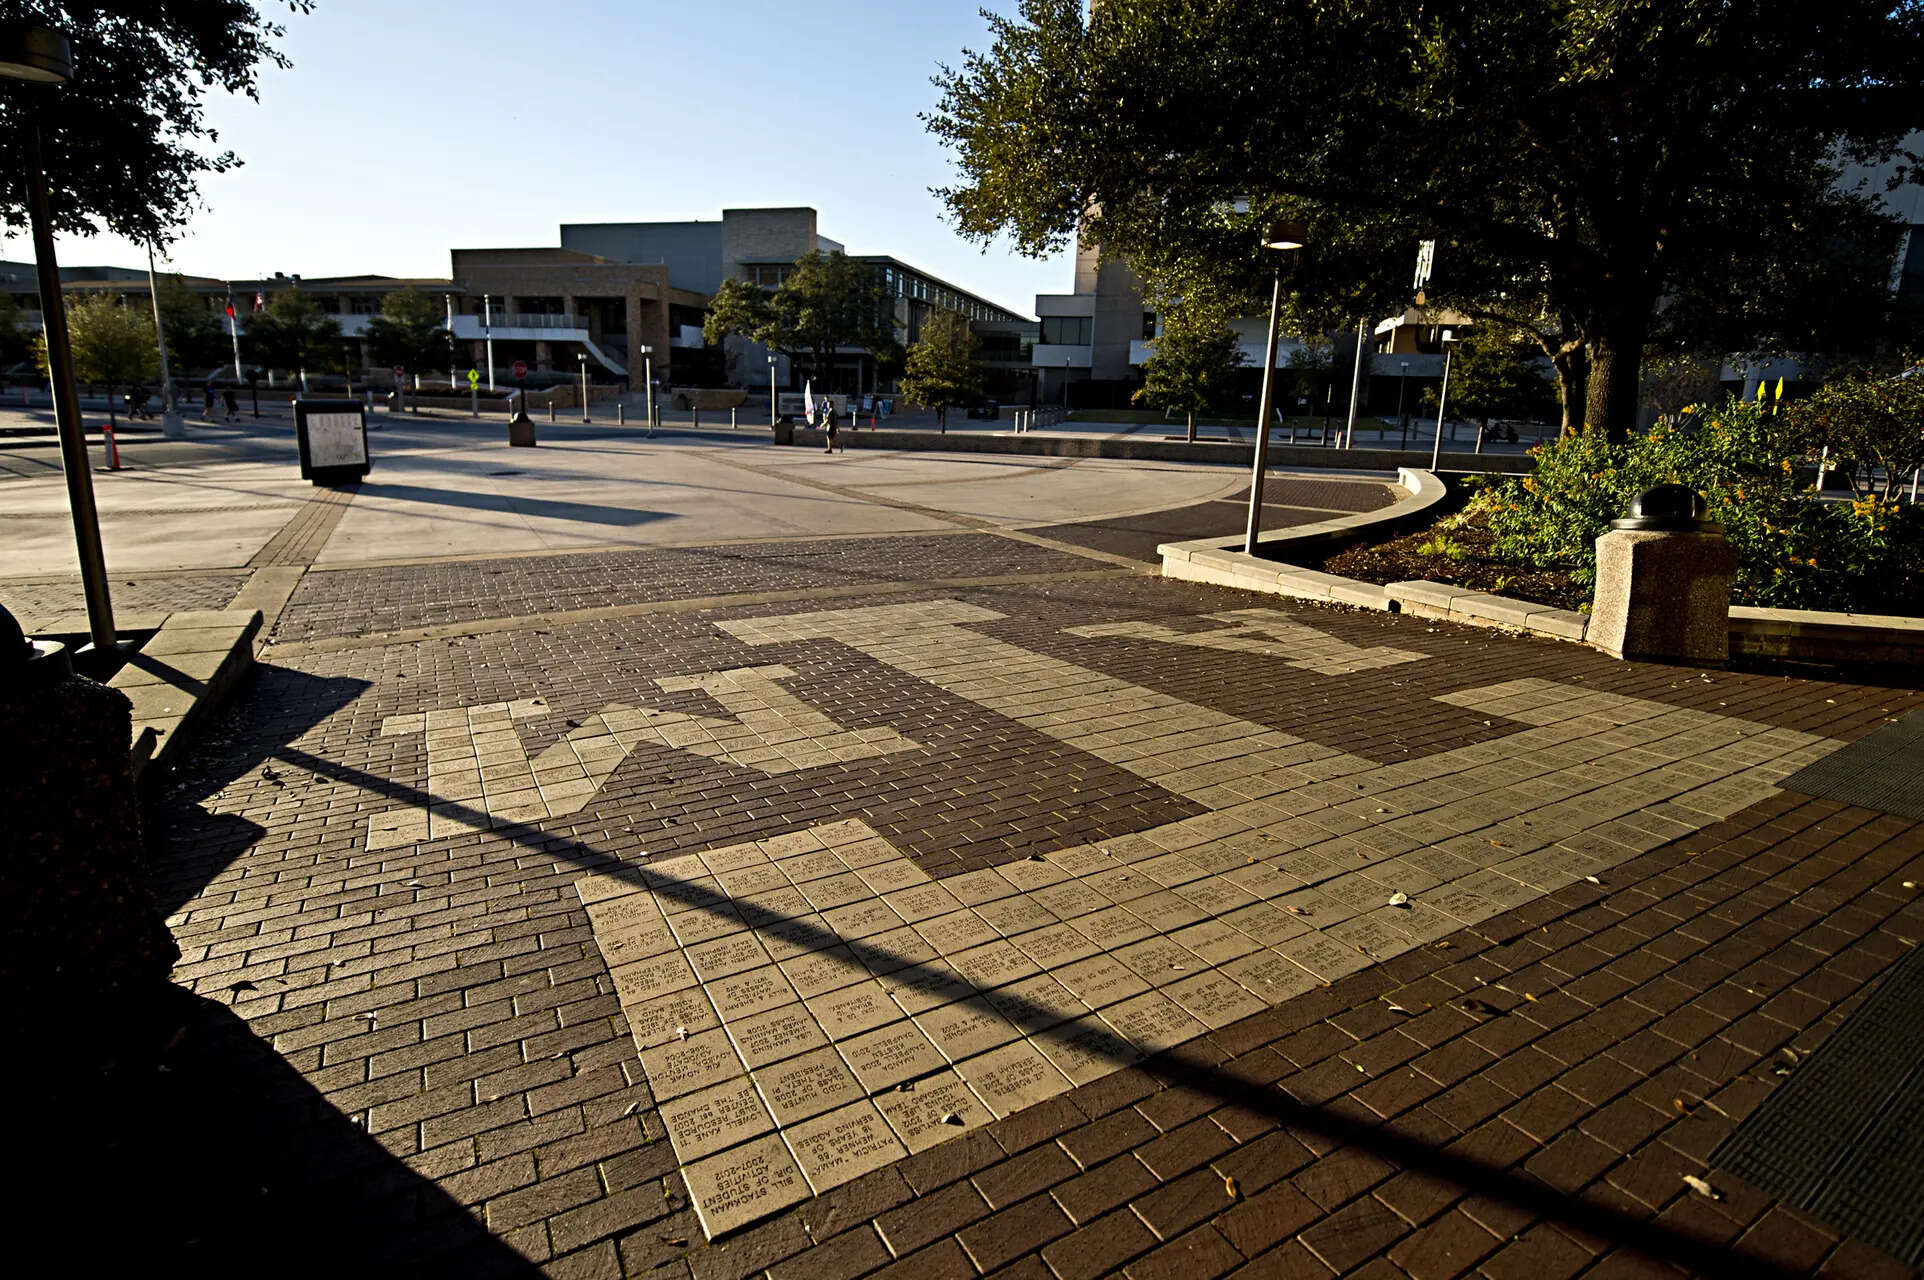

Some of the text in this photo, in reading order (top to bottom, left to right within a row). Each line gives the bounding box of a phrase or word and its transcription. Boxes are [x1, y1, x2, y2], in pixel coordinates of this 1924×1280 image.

[729, 938, 752, 947] LEAVE
[703, 952, 759, 971] LAUREN ALLEN
[706, 949, 731, 959] HEART
[633, 977, 654, 987] REED
[639, 981, 661, 991] REED
[738, 980, 773, 994] CLASSES
[766, 988, 788, 997] BILLY
[641, 998, 692, 1017] AGGIE BAND
[722, 998, 754, 1011] SHERRY
[638, 1013, 663, 1024] TEXAS
[676, 1007, 704, 1019] CLASS
[680, 1012, 709, 1024] JAMES
[769, 1015, 795, 1026] CLASS
[739, 1017, 809, 1043] JAMES MANNING
[771, 1025, 807, 1040] JIMENEZ
[940, 1024, 979, 1041] MAHONEY
[751, 1038, 791, 1054] MANNING
[871, 1031, 914, 1049] CAMPBELL
[870, 1042, 905, 1058] KRISTEN
[882, 1042, 926, 1062] CAMPBELL
[666, 1049, 712, 1068] ADVOCATE
[880, 1055, 916, 1071] AMANDA
[996, 1055, 1037, 1074] JEREMIAH
[650, 1064, 689, 1081] MENTOR
[669, 1068, 700, 1083] NOVAK
[778, 1062, 825, 1083] PRESIDENT
[814, 1073, 845, 1088] CLASS
[815, 1066, 839, 1079] BETA
[982, 1062, 1044, 1090] CLASS OF 2012
[1030, 1071, 1046, 1080] LIZ
[782, 1075, 814, 1091] THETA
[799, 1084, 813, 1093] OF
[780, 1081, 847, 1109] TODD HUNTER
[883, 1081, 960, 1114] WAKEBOARD TEAM
[669, 1089, 749, 1122] BE THE CHANGE
[717, 1096, 755, 1114] CENTER
[900, 1097, 968, 1128] CLASS OF 2012
[901, 1092, 955, 1117] YOUNG LIFE
[672, 1117, 695, 1130] 2007
[676, 1114, 728, 1138] RESOURCE
[724, 1110, 763, 1129] LOWELL
[833, 1113, 874, 1134] SERVING
[693, 1126, 721, 1141] KANE
[826, 1130, 857, 1146] YEARS
[810, 1143, 824, 1153] OF
[851, 1136, 894, 1158] PATRICIA
[712, 1155, 764, 1180] 2007-2012
[715, 1163, 770, 1190] ACTIVITIES
[752, 1174, 768, 1187] OF
[701, 1182, 751, 1207] STUDENT
[710, 1176, 793, 1215] BILL STACKMAN
